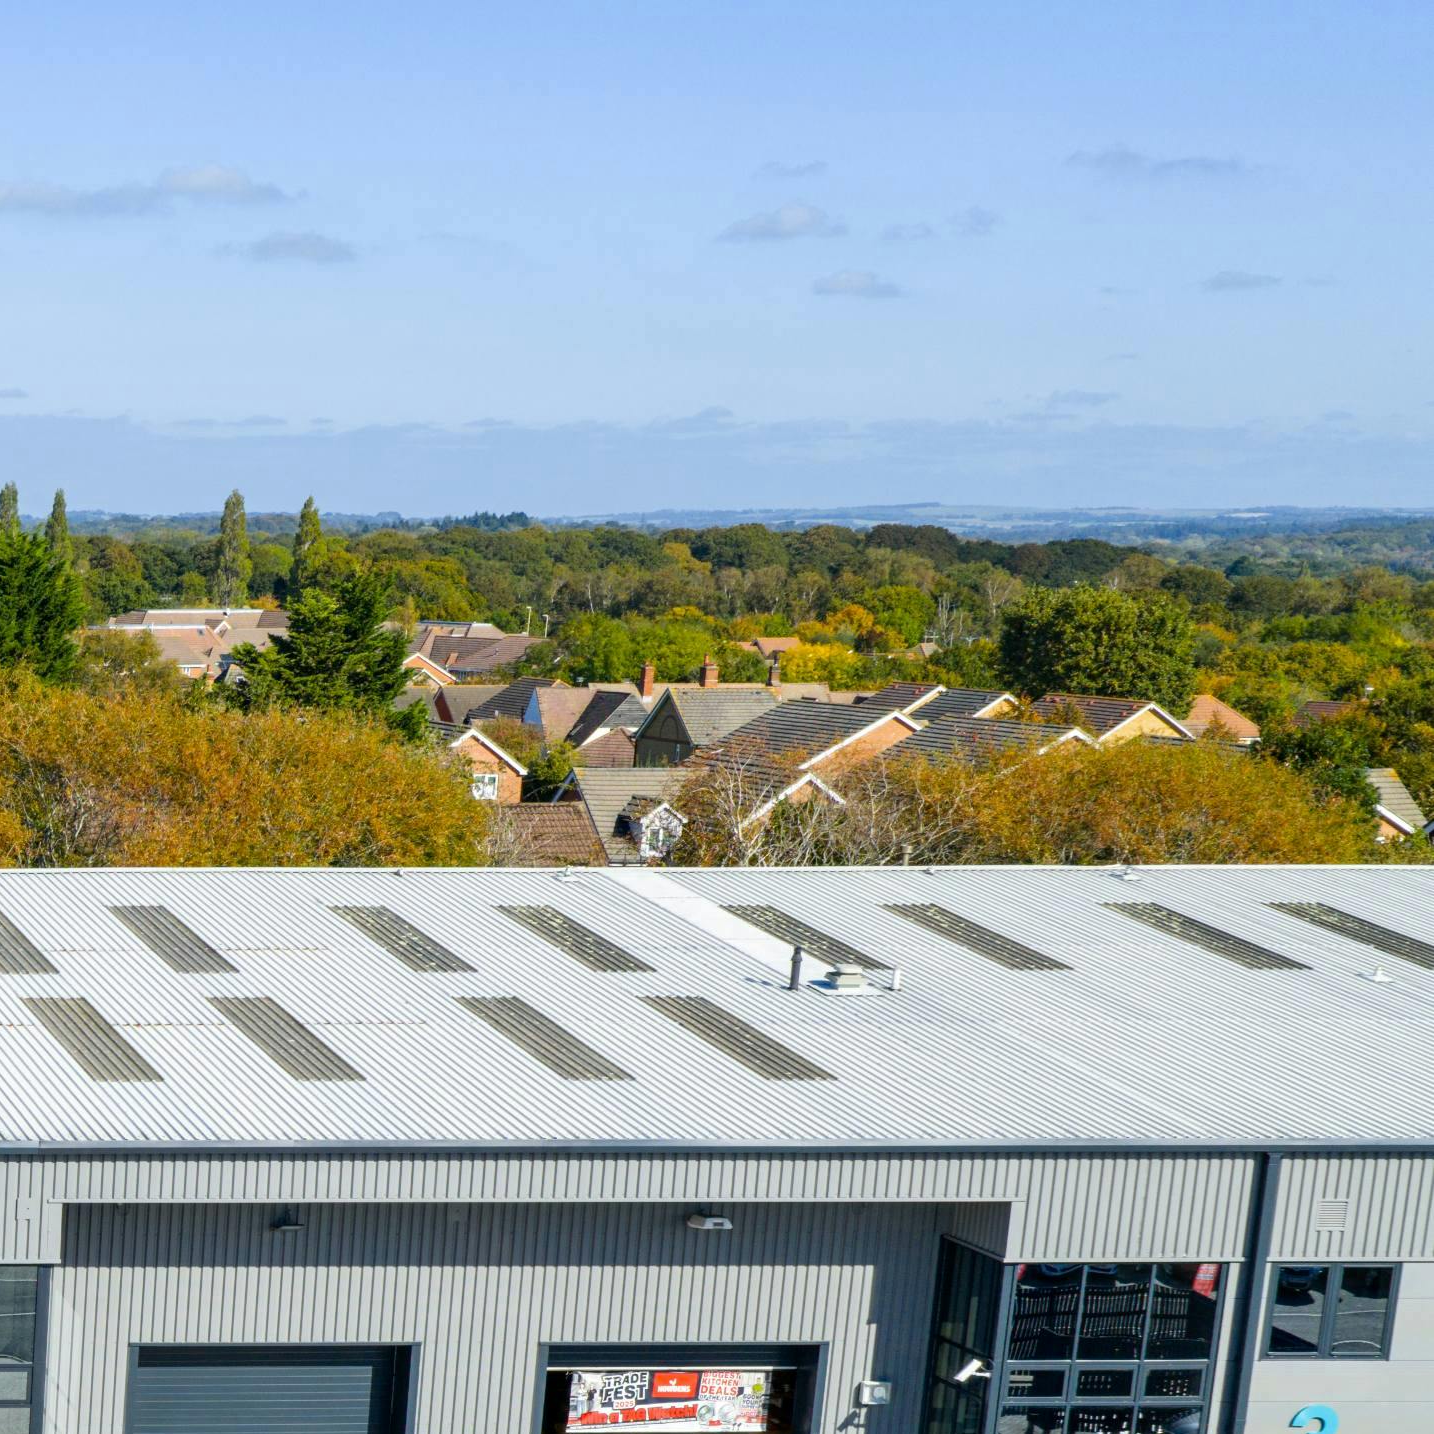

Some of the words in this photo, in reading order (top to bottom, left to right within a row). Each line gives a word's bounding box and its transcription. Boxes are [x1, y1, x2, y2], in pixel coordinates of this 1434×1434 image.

[604, 1373, 648, 1387] TRADE
[702, 1378, 739, 1387] KITCHEN
[603, 1384, 647, 1402] FEST
[700, 1385, 738, 1398] DEALS
[615, 1400, 634, 1408] 2025
